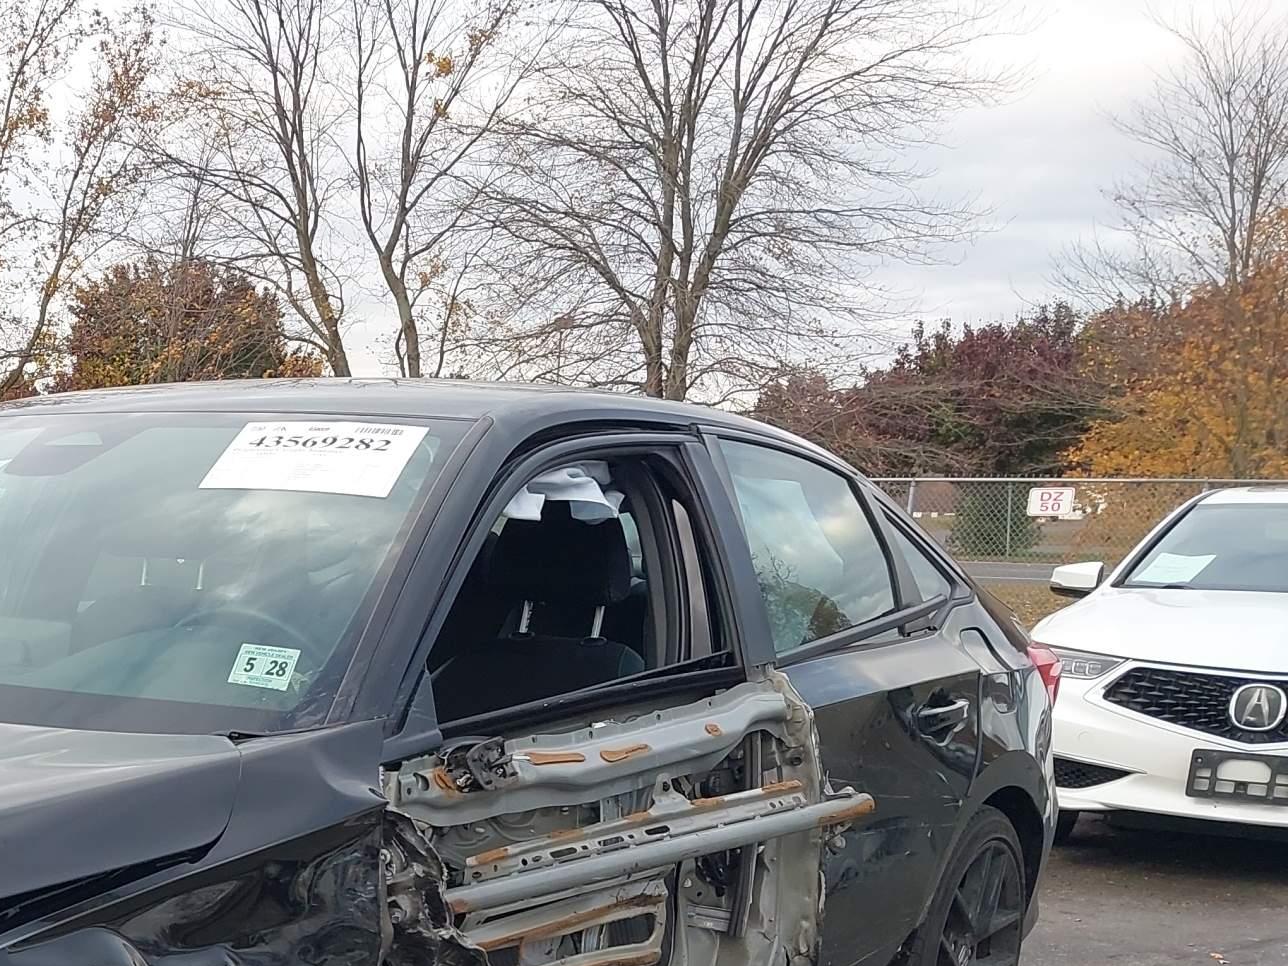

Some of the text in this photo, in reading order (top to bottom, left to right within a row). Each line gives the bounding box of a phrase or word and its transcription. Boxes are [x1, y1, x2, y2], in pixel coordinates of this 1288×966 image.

[249, 435, 391, 451] 43569282
[1040, 491, 1065, 502] DZ
[1039, 502, 1061, 512] 50
[243, 657, 289, 677] 5 28
